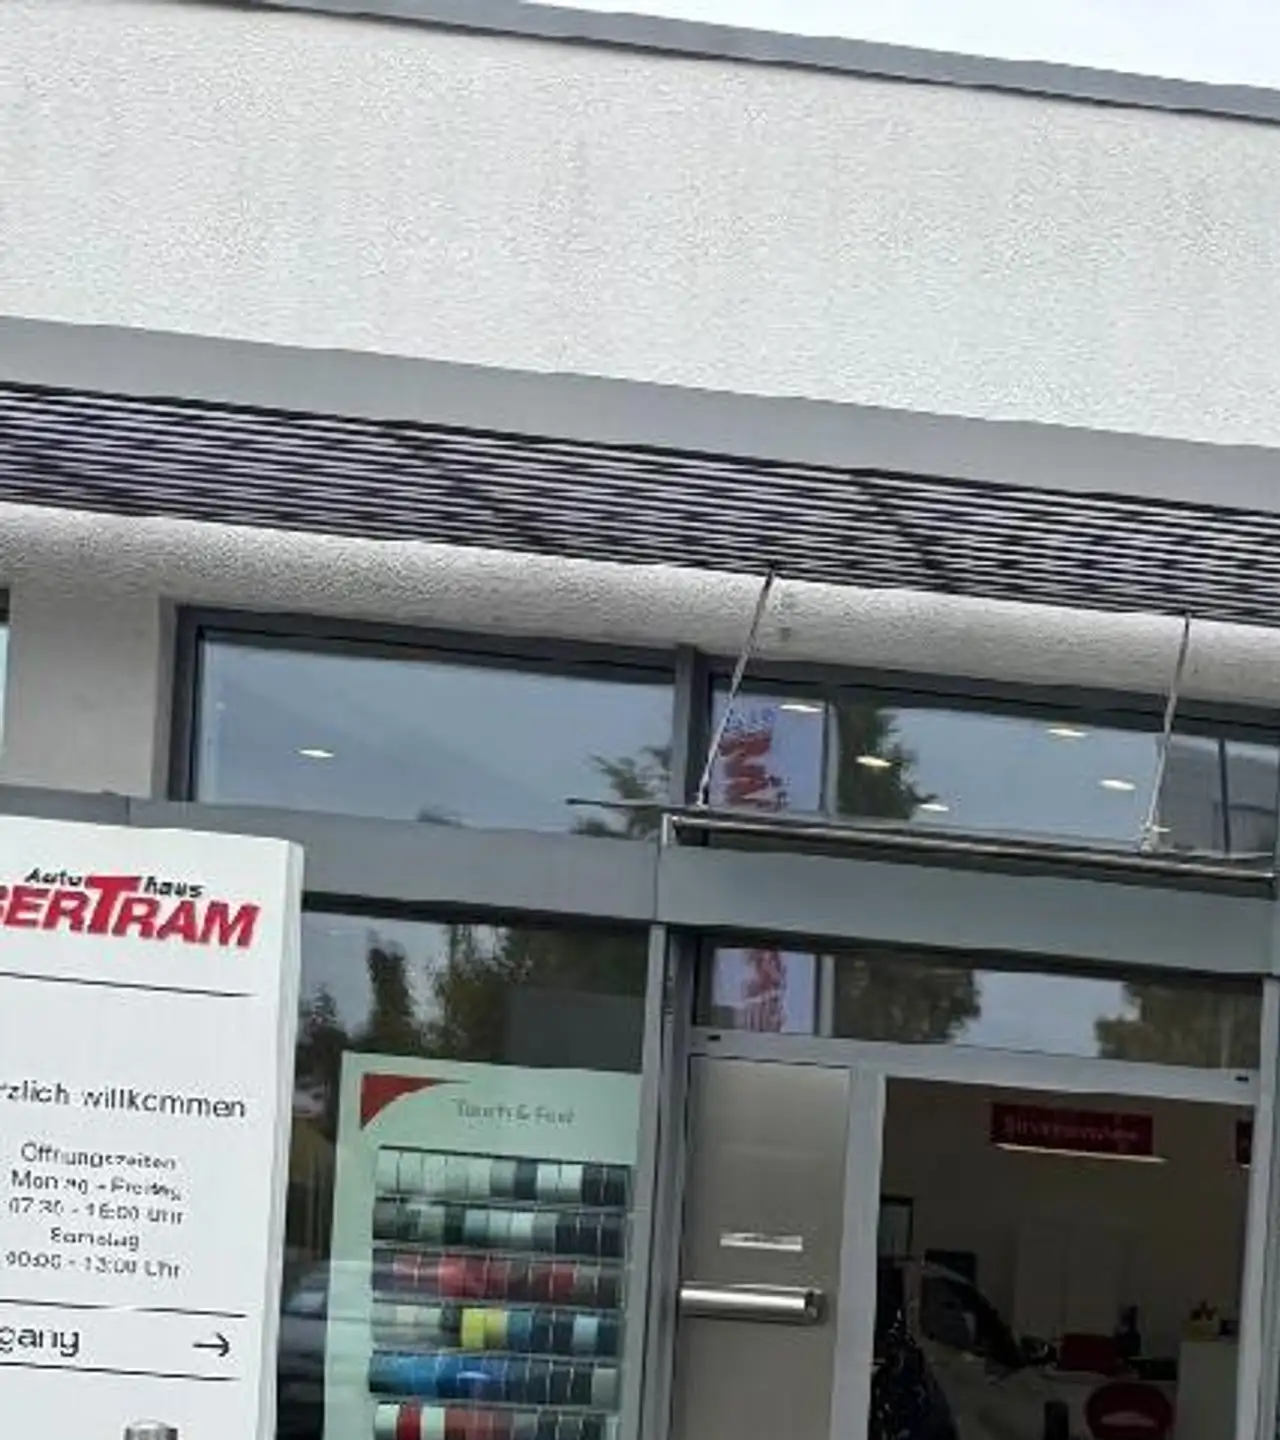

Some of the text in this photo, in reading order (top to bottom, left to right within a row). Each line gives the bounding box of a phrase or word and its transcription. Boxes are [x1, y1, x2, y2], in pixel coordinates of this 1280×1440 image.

[25, 868, 204, 898] Auto haus
[0, 876, 261, 947] ERTRAM
[83, 1086, 246, 1118] willkommen
